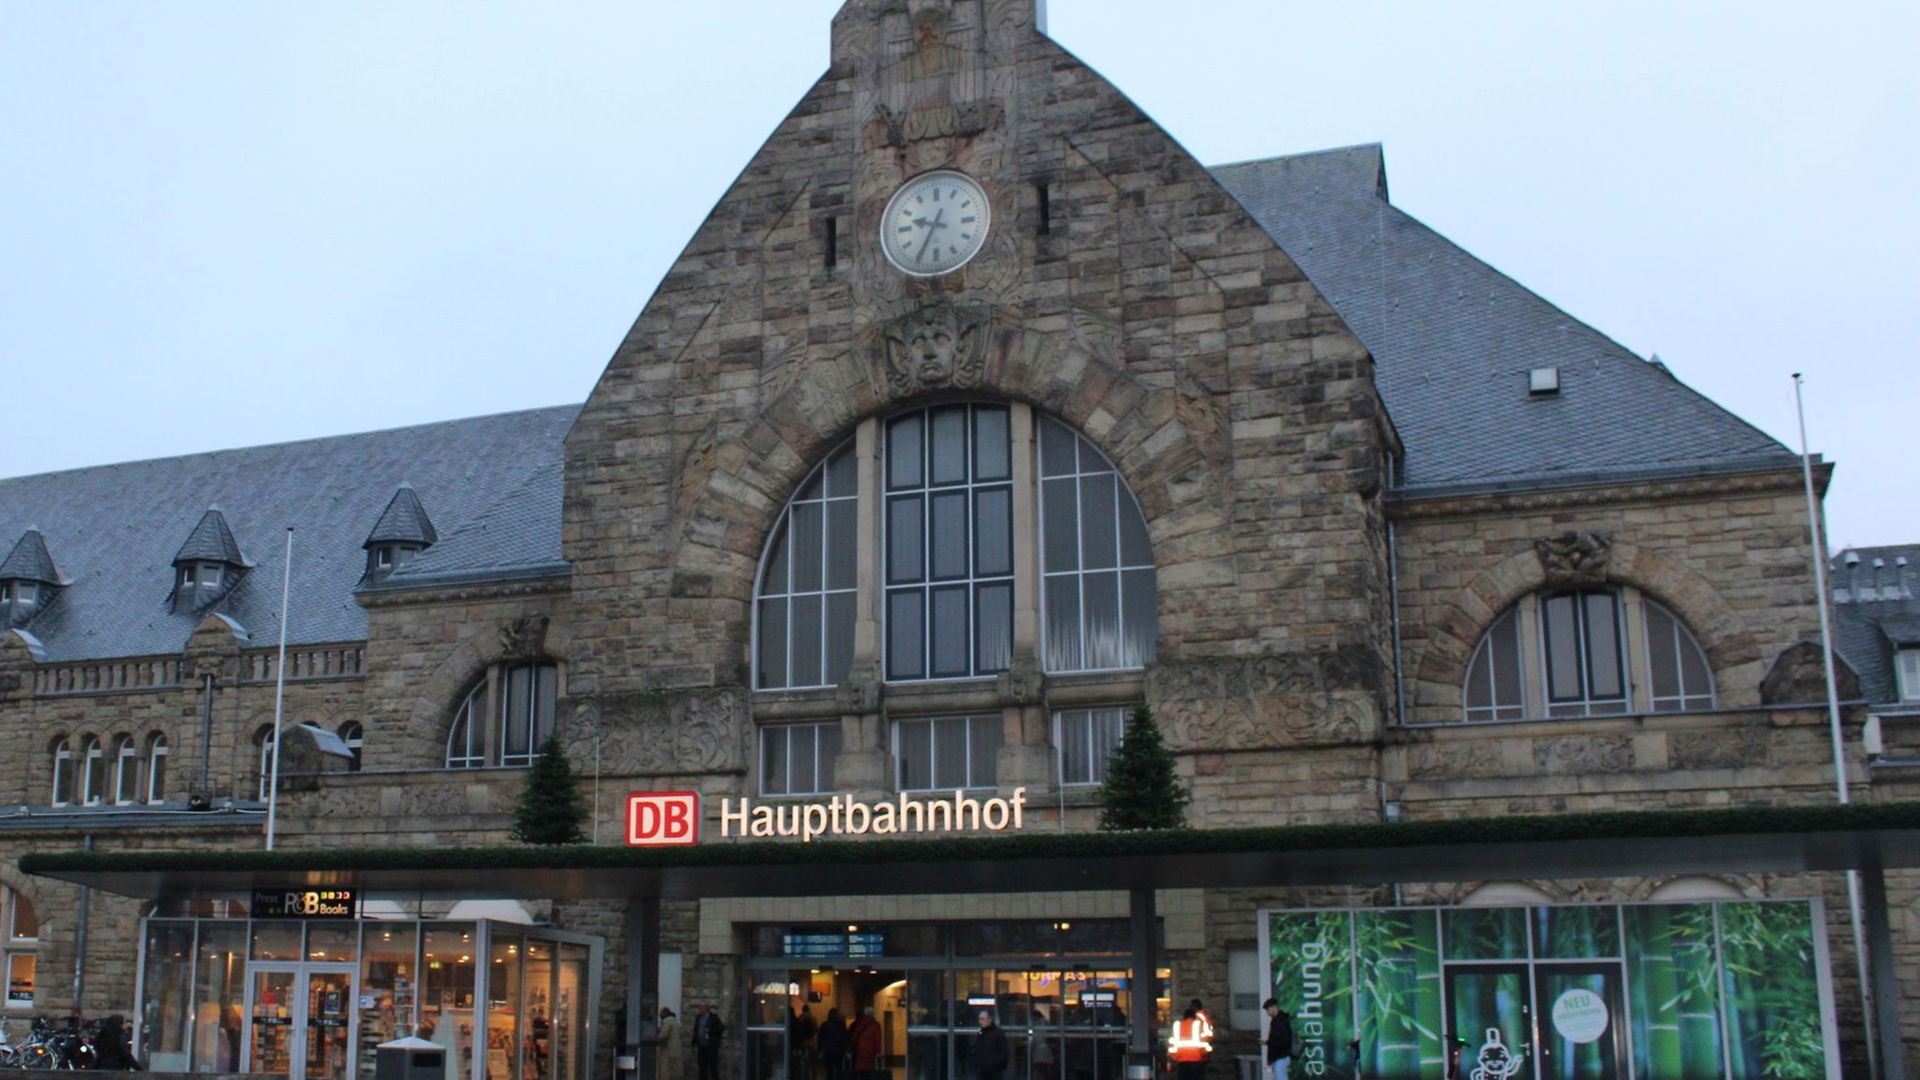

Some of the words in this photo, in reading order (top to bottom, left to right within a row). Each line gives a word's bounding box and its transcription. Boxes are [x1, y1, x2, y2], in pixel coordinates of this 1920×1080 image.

[634, 801, 689, 839] DB
[720, 787, 1027, 842] Hauptbahnhof
[320, 903, 349, 915] Books
[1297, 942, 1326, 1076] asiahung
[1563, 995, 1590, 1009] NEU
